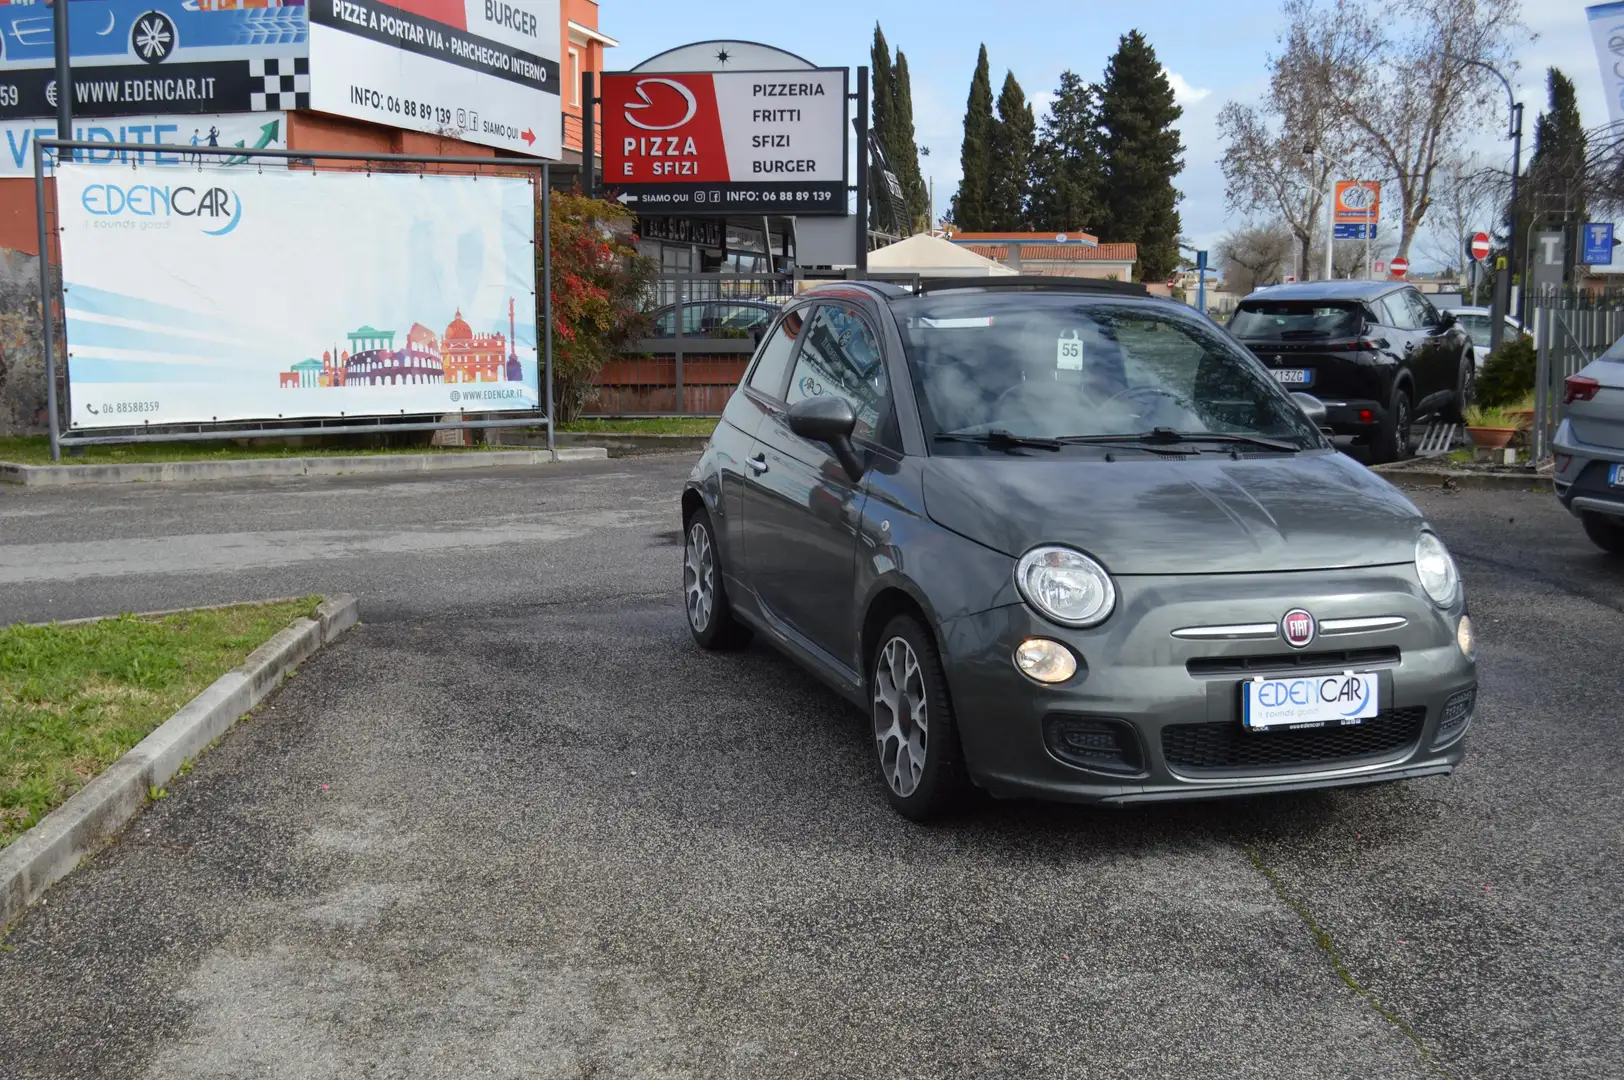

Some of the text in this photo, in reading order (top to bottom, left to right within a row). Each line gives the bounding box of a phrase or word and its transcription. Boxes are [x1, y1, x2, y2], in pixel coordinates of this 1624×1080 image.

[485, 0, 538, 38] BURGER
[333, 0, 547, 83] PIZZE A PORTAR VIA PARCHEGGIO INTERNO
[75, 78, 216, 103] WWW.EDENCAR.IT
[753, 83, 825, 96] PIZZERIA
[350, 85, 519, 141] INFO: 06 88 89 139 SIAMO QUI
[753, 109, 801, 122] FRITTI
[623, 136, 697, 156] PIZZA
[752, 135, 790, 148] SFIZI
[623, 161, 698, 175] E SFIZI
[752, 160, 816, 173] BURGER
[82, 184, 231, 217] EDENCAR
[642, 191, 831, 203] SIAMO QUI INFO: 06 88 89 139
[93, 219, 135, 228] sounds
[1062, 343, 1079, 357] 55
[463, 389, 523, 400] WWW.EDENCAR.IT
[102, 403, 114, 414] 06
[1290, 619, 1308, 637] FIAT
[1258, 677, 1362, 707] EDENCAR
